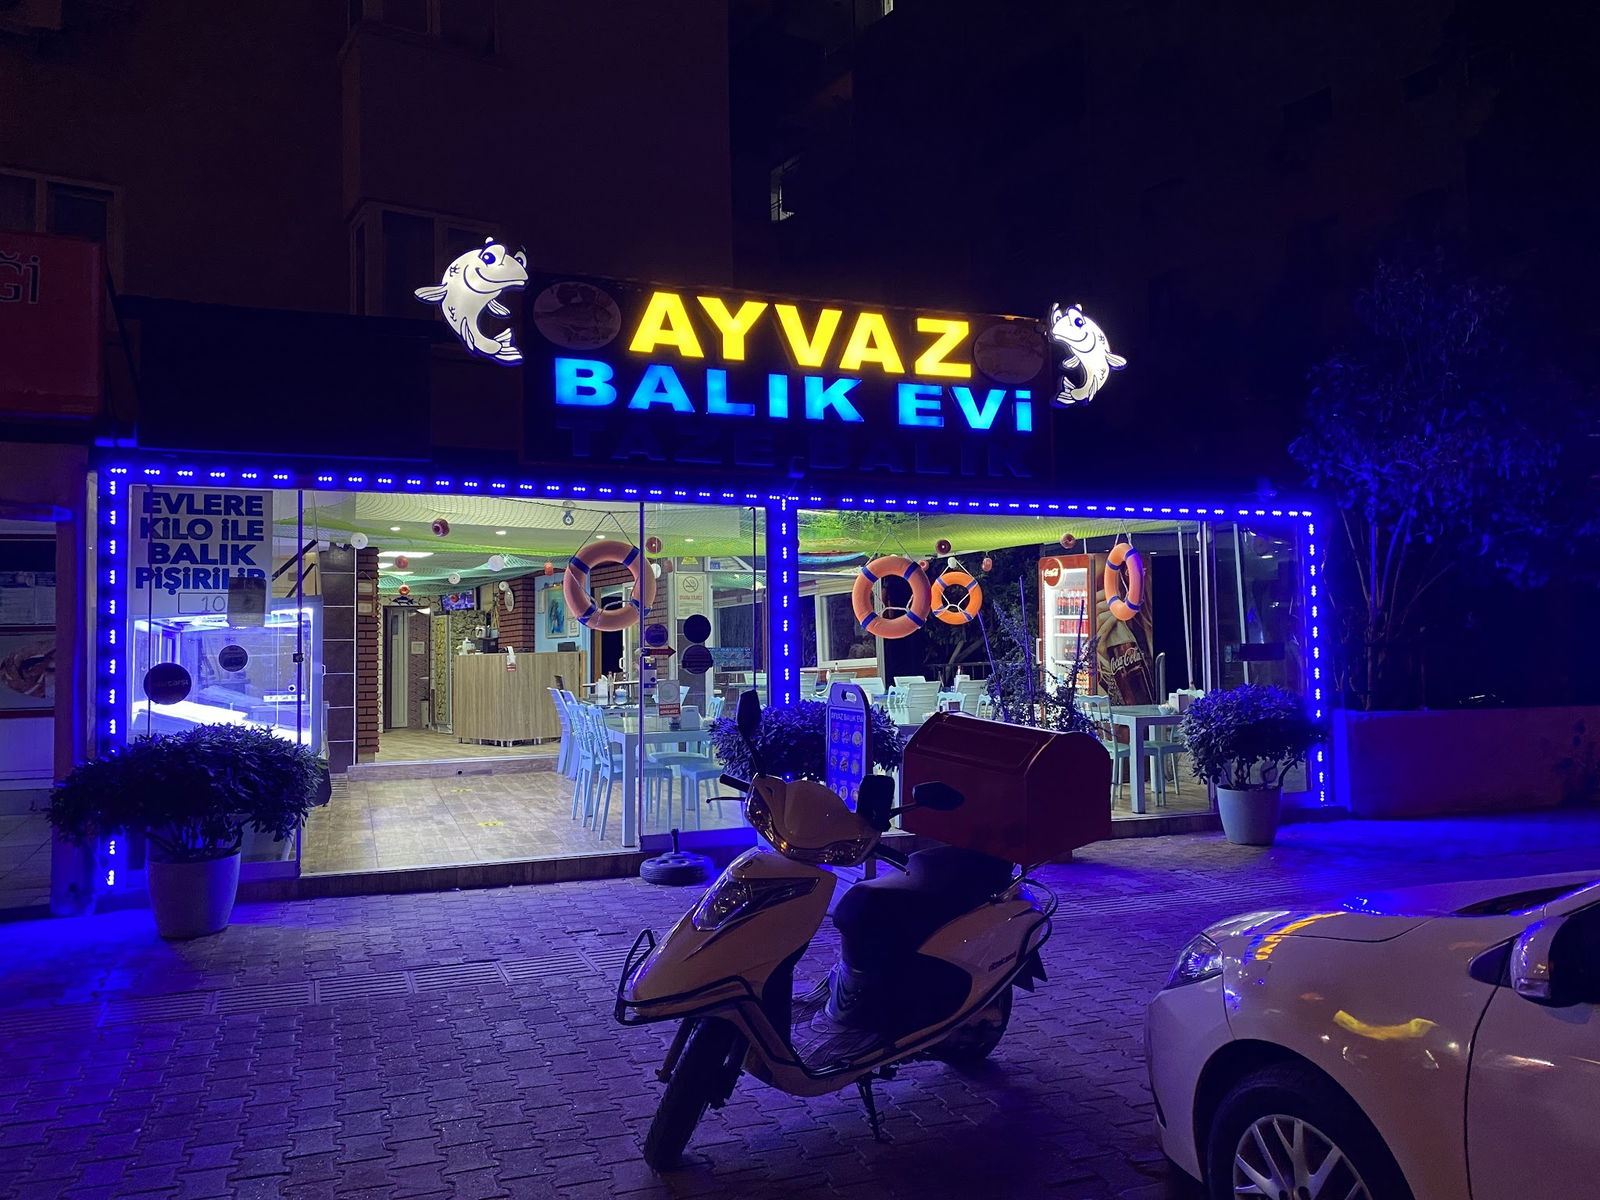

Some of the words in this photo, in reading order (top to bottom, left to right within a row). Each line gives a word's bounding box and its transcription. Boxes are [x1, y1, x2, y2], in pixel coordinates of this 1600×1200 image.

[628, 290, 972, 379] AYVAZ
[554, 356, 865, 423] BALIK
[143, 491, 264, 517] EVLERE
[148, 542, 257, 566] BALIK
